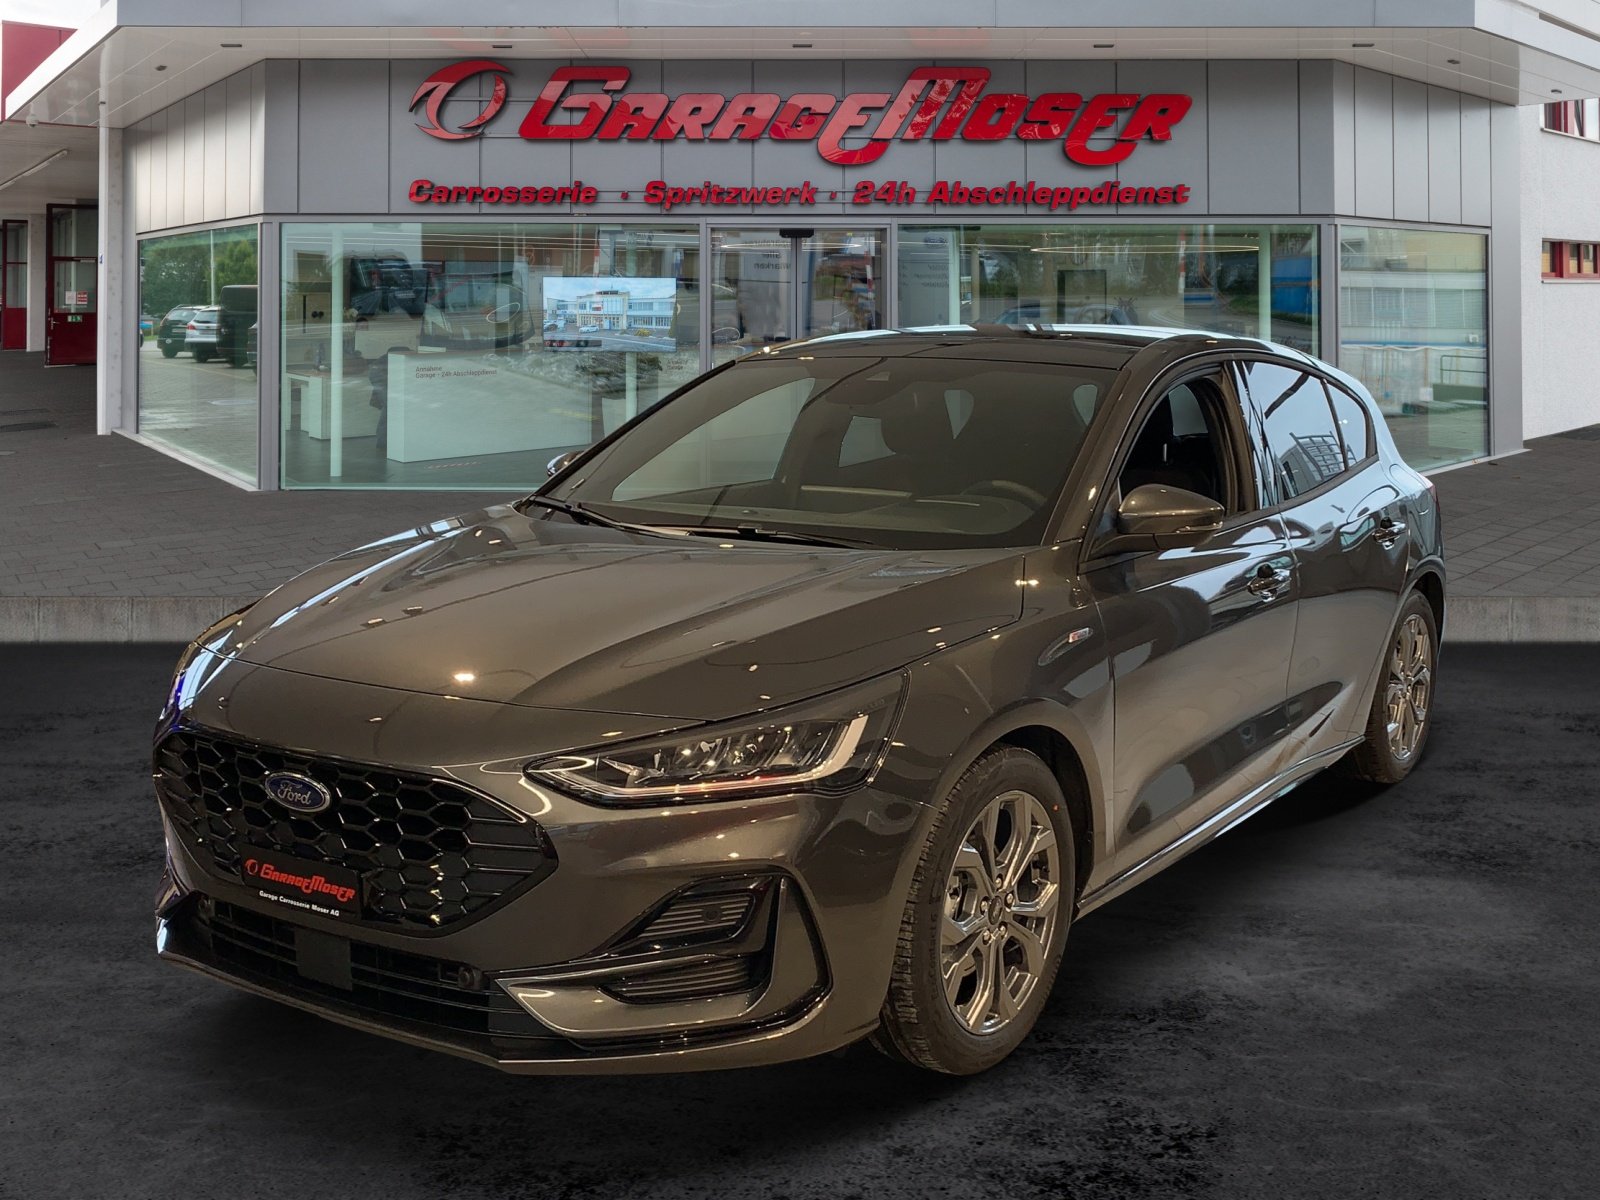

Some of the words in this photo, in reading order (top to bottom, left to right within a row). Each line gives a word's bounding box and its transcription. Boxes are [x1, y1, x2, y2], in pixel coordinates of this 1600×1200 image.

[408, 179, 598, 204] Carrosserie
[644, 180, 817, 210] Spritzwerk
[853, 180, 917, 204] 24h
[927, 181, 1191, 210] Abschleppdienst
[277, 780, 312, 805] Ford
[259, 890, 278, 901] Garage
[279, 895, 311, 909] Carrosserie
[311, 903, 329, 914] Moser
[329, 909, 340, 917] AG
